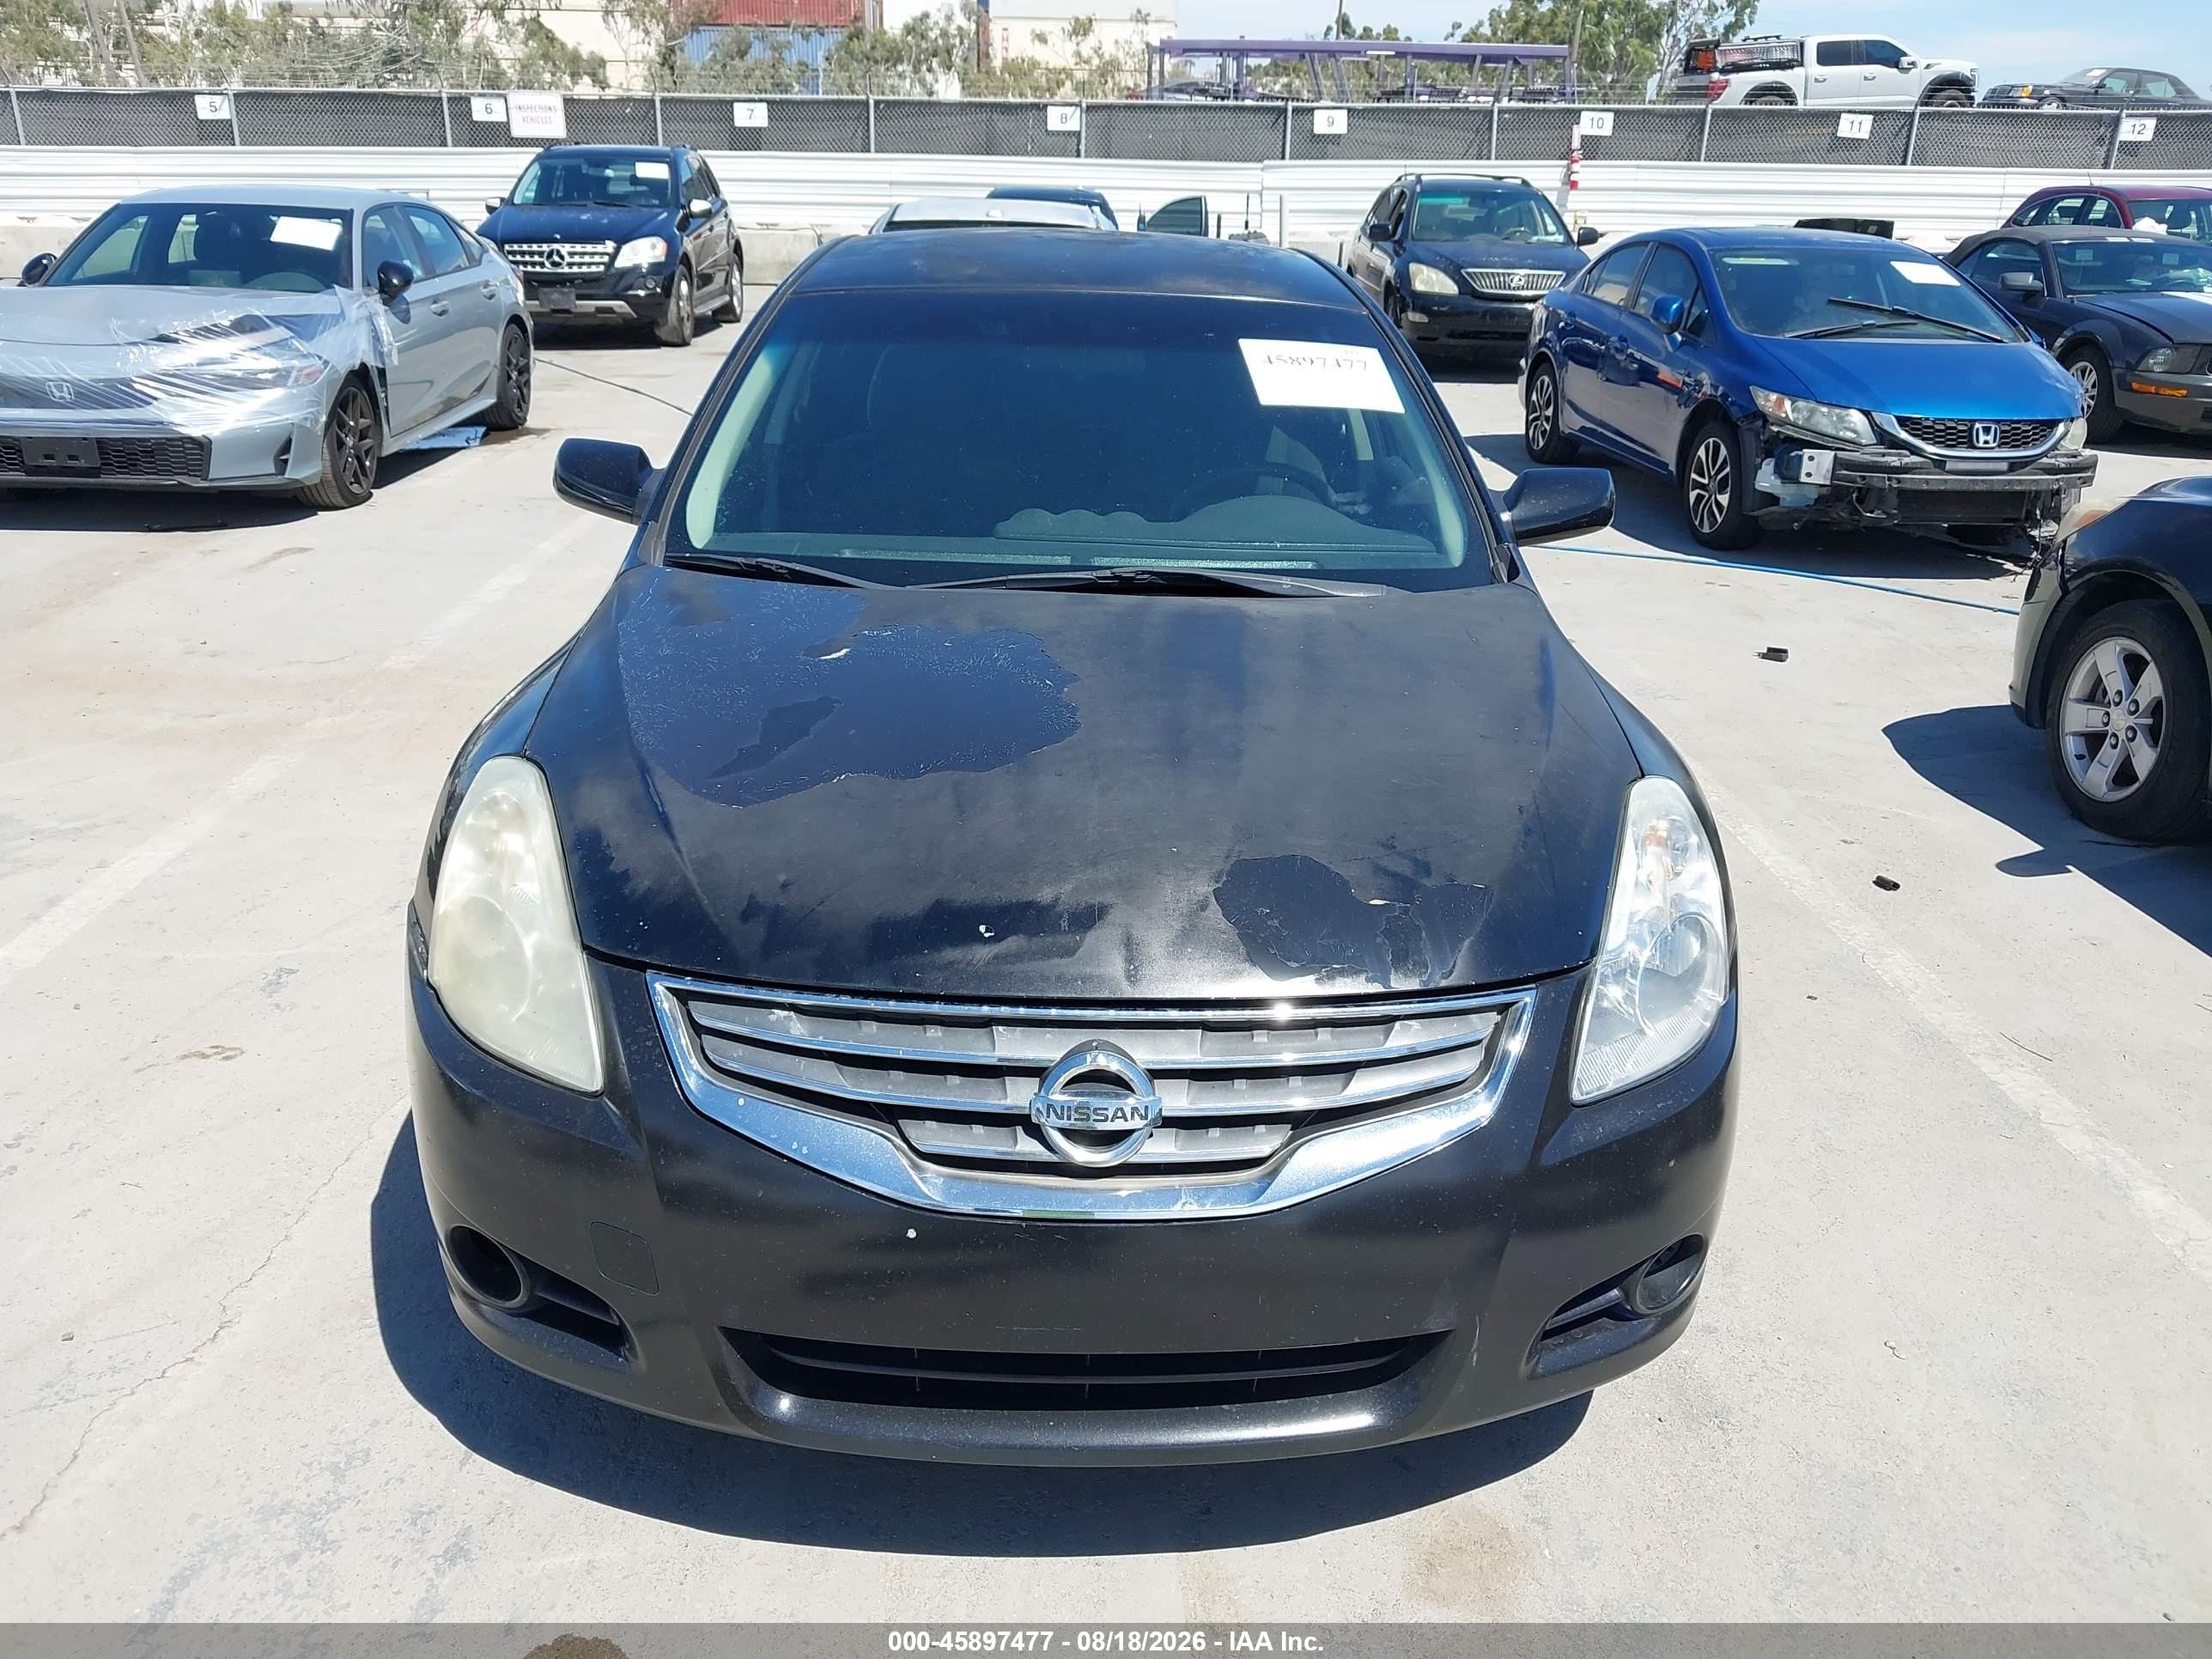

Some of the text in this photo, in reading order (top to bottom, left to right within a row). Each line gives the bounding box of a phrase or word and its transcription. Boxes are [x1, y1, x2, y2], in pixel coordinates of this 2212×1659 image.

[209, 100, 219, 113] 5
[484, 102, 494, 115] 6
[522, 115, 553, 125] VEHICLES
[746, 107, 755, 120] 7
[1060, 112, 1069, 125] 8
[1326, 115, 1335, 128] 9
[1589, 116, 1605, 130] 10
[1848, 118, 1863, 132] 11
[2130, 122, 2147, 136] 12
[1045, 1103, 1150, 1123] NISSAN
